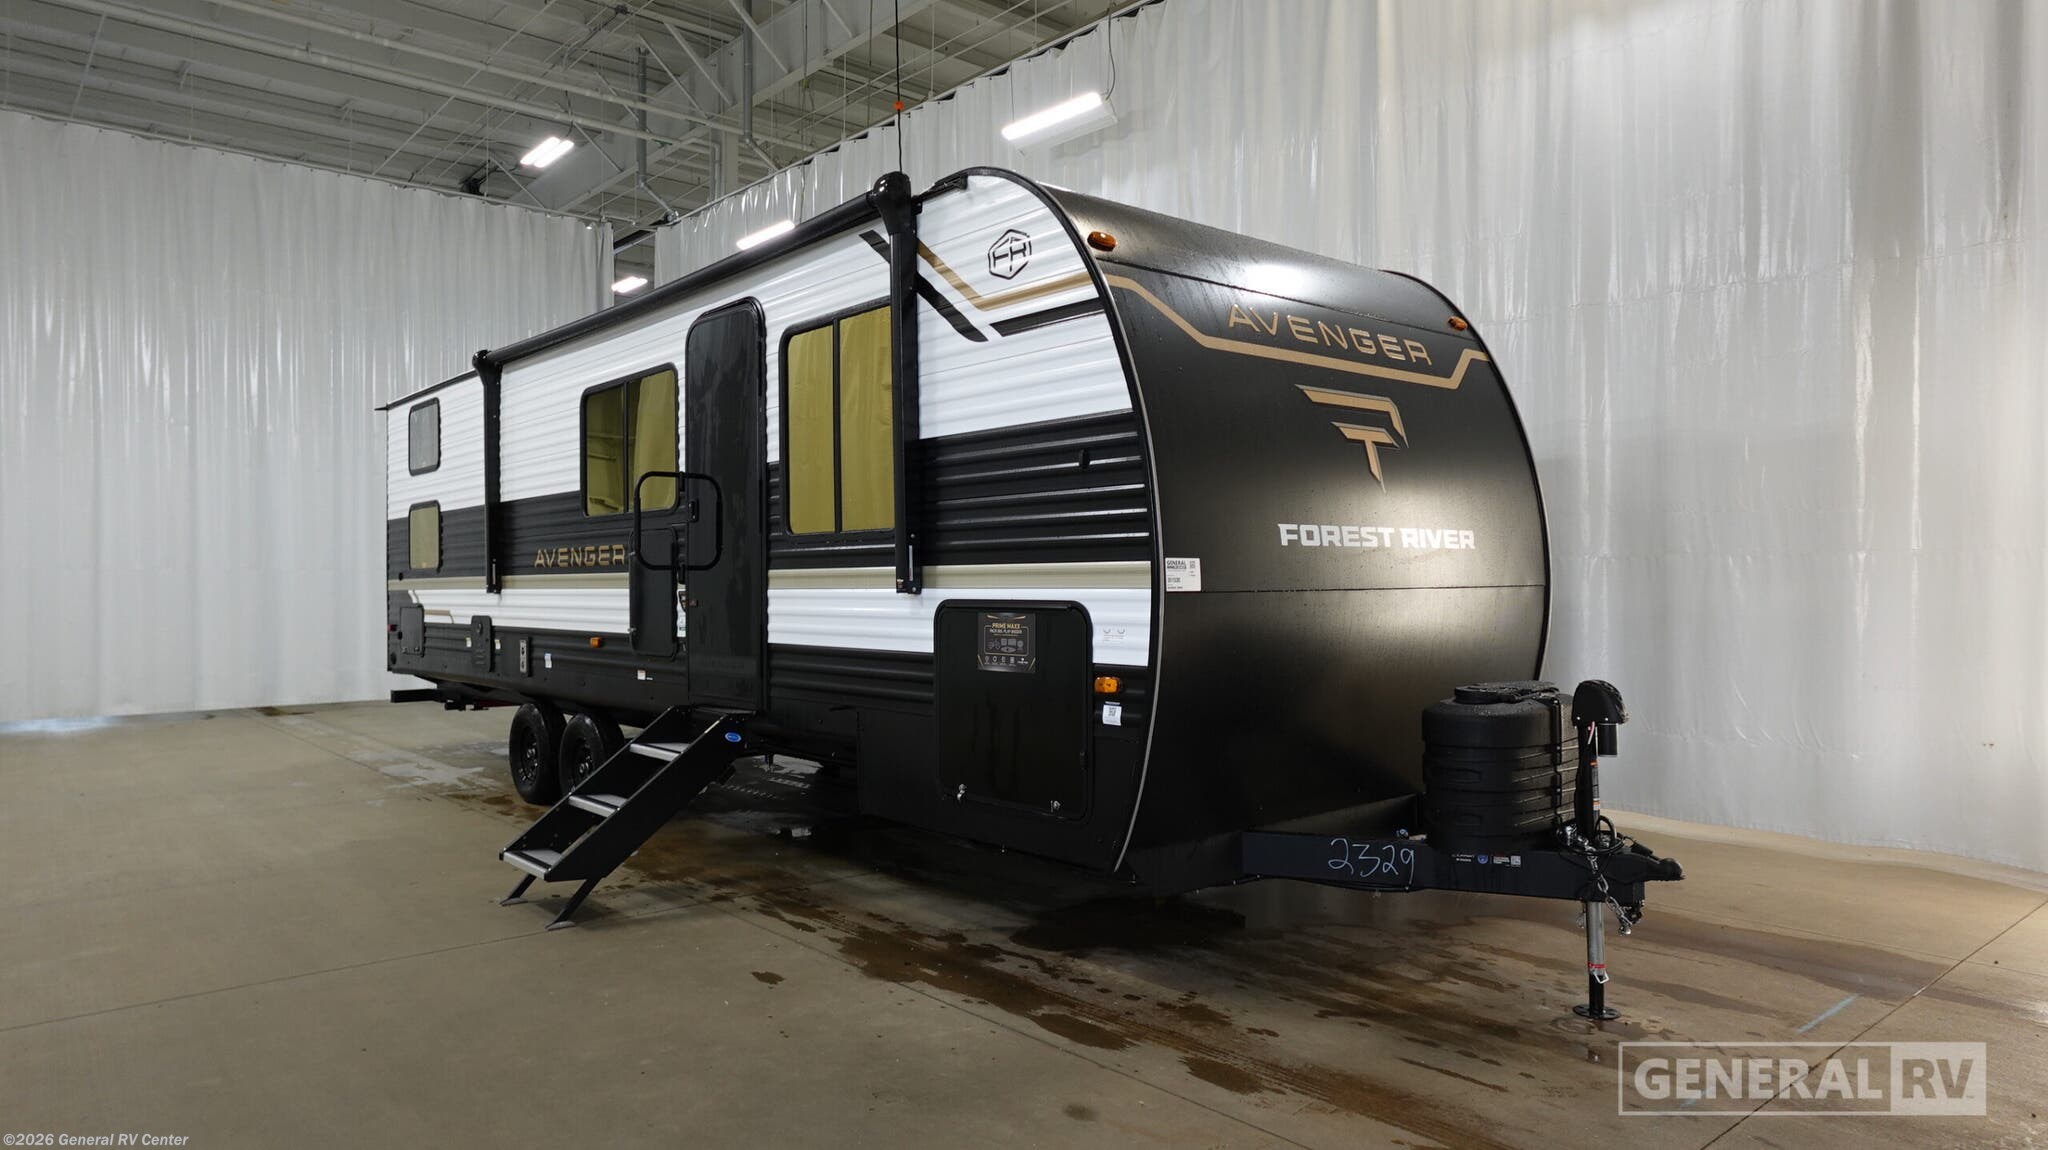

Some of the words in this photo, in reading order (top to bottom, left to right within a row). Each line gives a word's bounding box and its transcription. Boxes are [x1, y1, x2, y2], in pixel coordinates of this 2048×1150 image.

[1228, 303, 1433, 366] AVENGER
[1278, 523, 1395, 548] FOREST
[1399, 527, 1476, 550] RIVER
[534, 544, 625, 568] AVENGER
[1327, 837, 1415, 886] 2329
